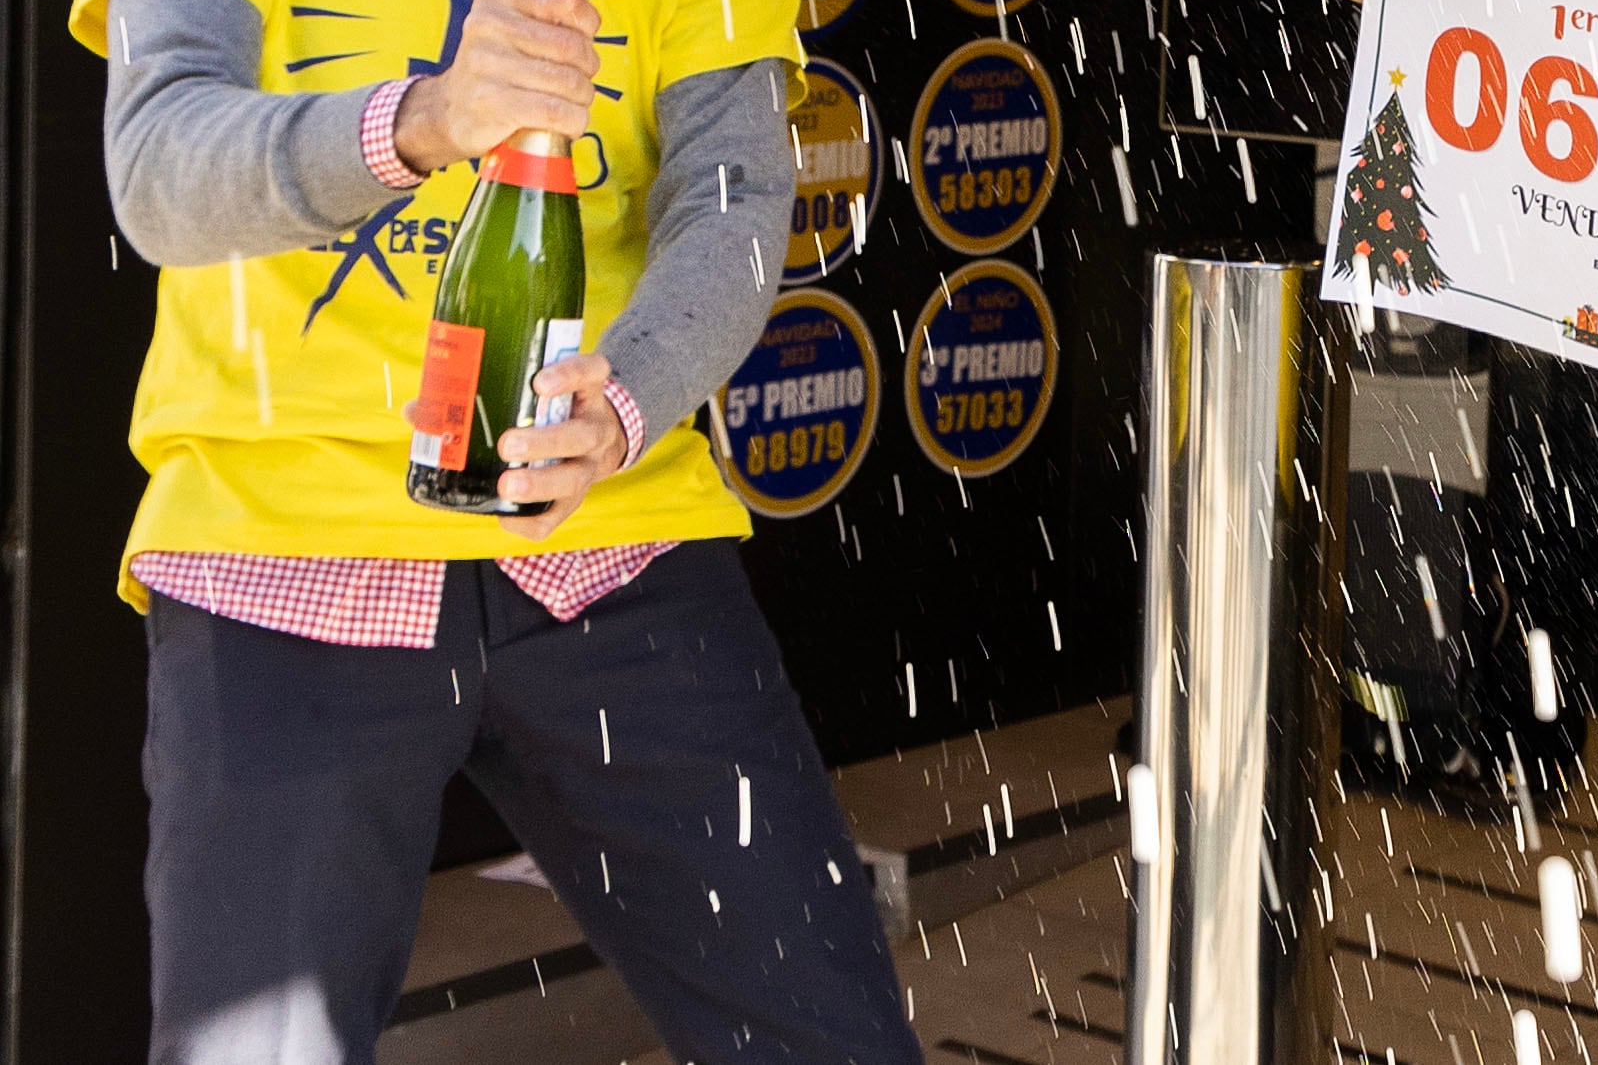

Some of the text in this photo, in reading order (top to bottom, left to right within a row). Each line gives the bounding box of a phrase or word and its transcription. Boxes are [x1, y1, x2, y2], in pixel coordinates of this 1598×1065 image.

[1552, 5, 1598, 40] 1er
[923, 115, 1048, 166] 2º PREMIO
[938, 165, 1033, 214] 58303
[951, 338, 1044, 384] PREMIO
[726, 366, 866, 430] 5º PREMIO
[936, 388, 1024, 436] 57033
[746, 420, 847, 477] 88979
